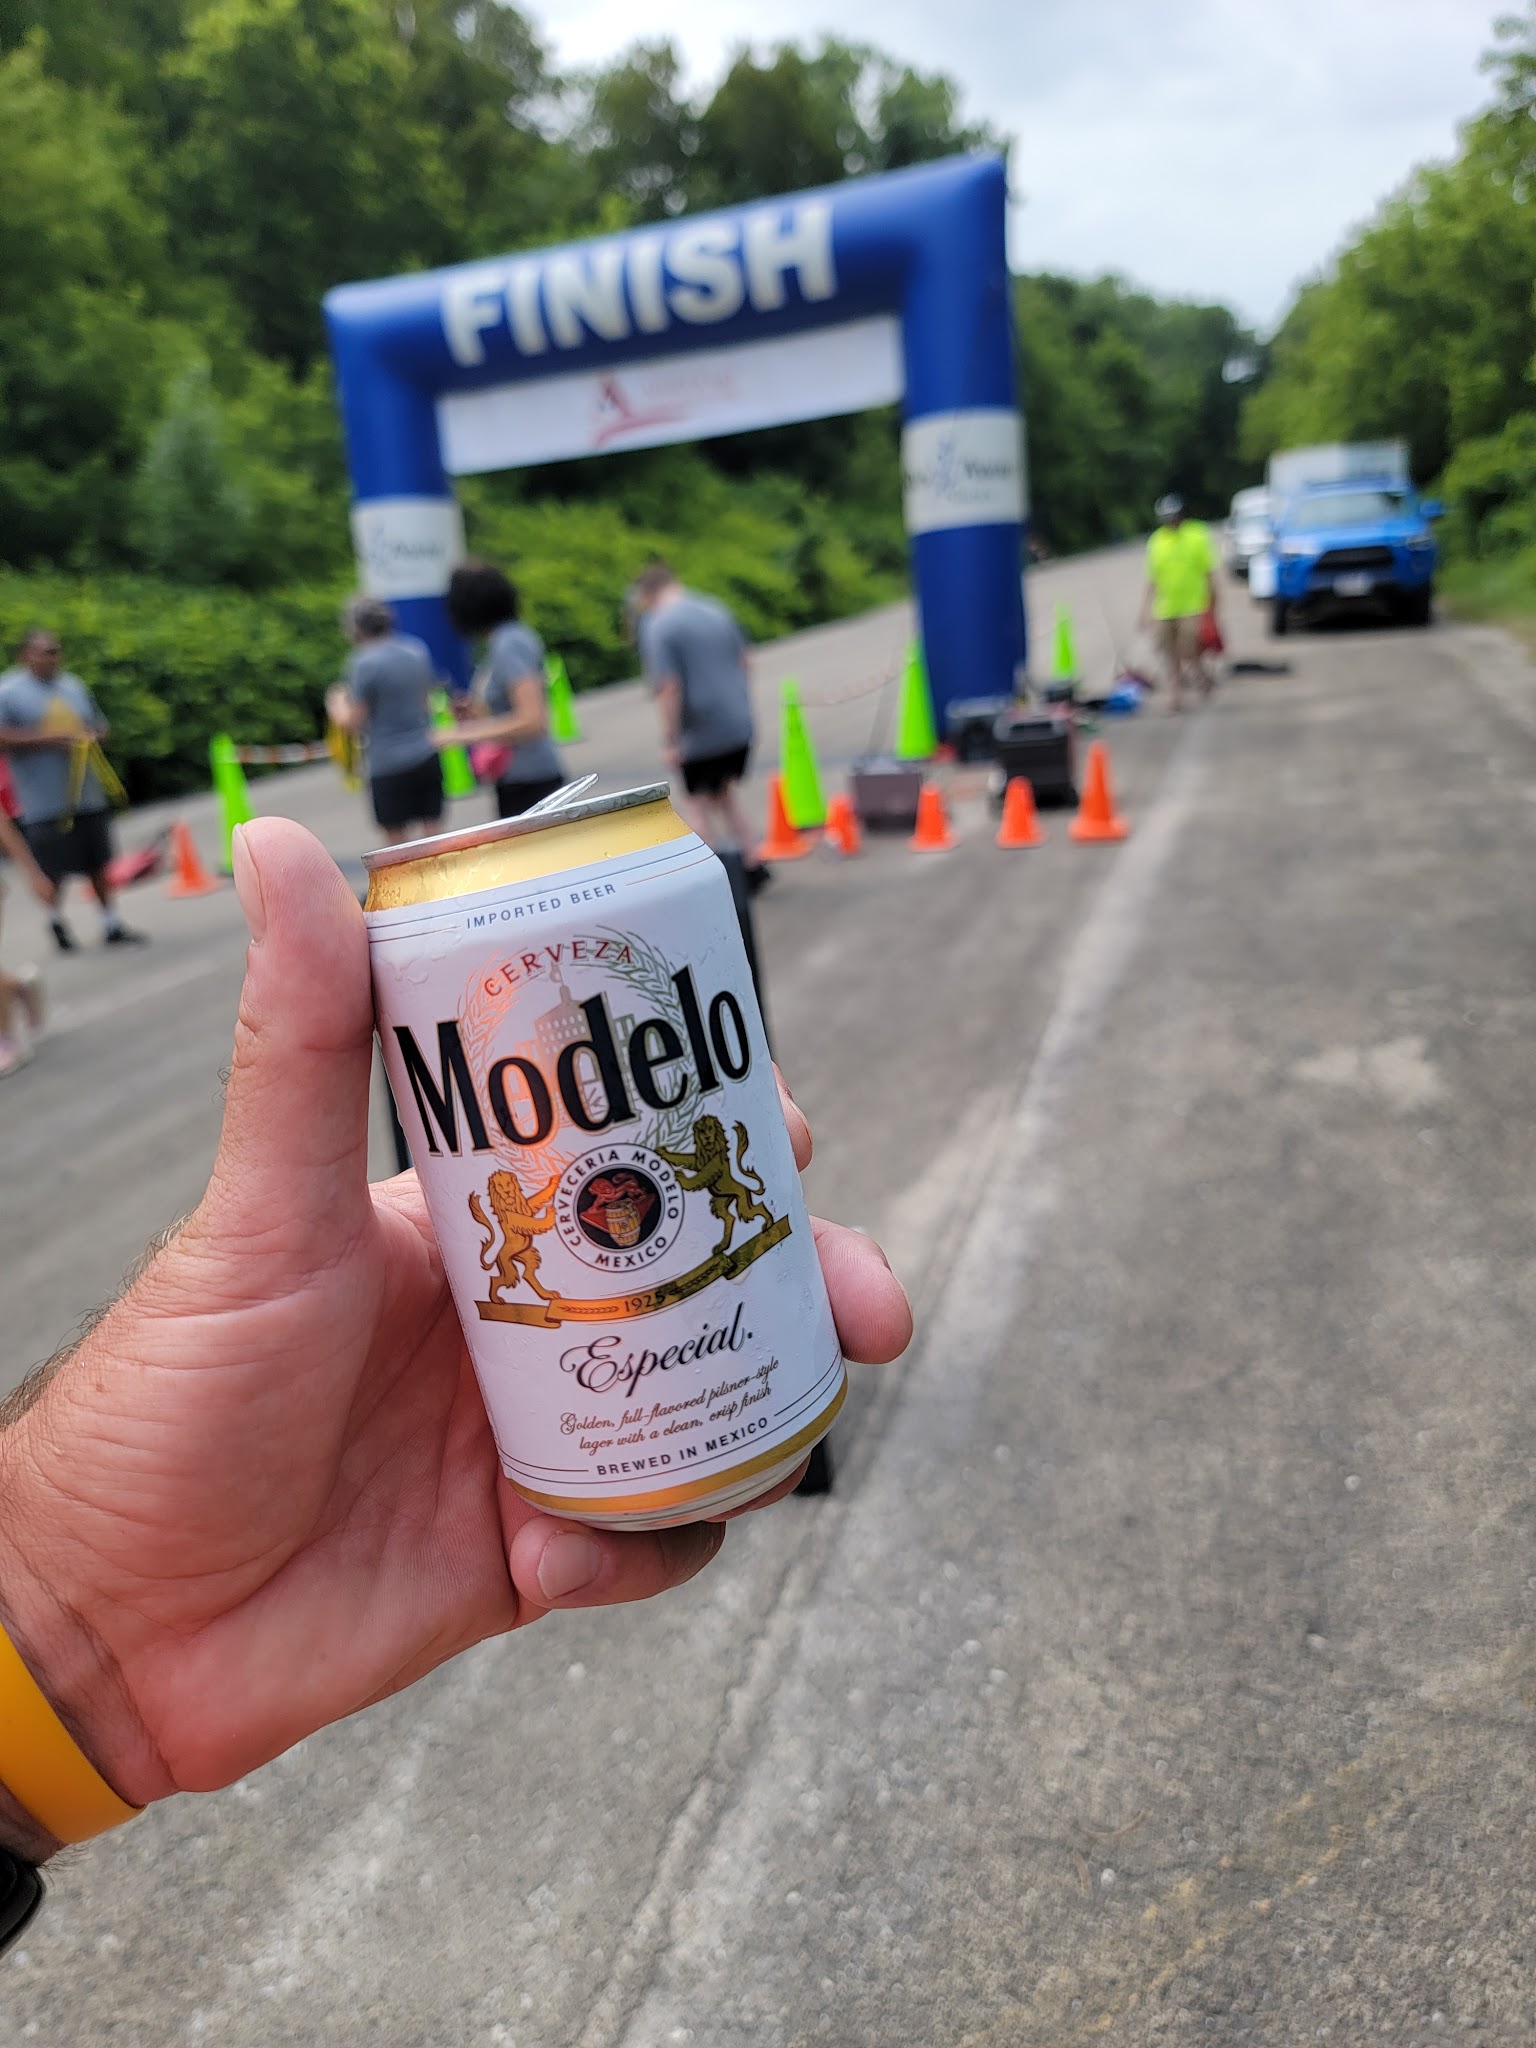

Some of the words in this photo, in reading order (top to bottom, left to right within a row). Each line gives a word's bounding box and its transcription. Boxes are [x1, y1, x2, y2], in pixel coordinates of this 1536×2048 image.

[440, 202, 838, 367] FINISH
[466, 898, 561, 929] IMPORTED
[570, 884, 616, 905] BEER
[484, 940, 633, 997] CERVEZA
[393, 964, 752, 1157] Modelo
[558, 1150, 619, 1246] CERVECERIA
[631, 1150, 679, 1219] MODELO
[595, 1236, 667, 1268] MEXICO
[624, 1292, 666, 1313] 1925
[560, 1412, 615, 1435] Golden,
[614, 1389, 706, 1431] full-flavored
[705, 1356, 779, 1408] pilsner-style
[579, 1437, 613, 1456] lager
[616, 1428, 646, 1446] with
[649, 1429, 659, 1440] a
[663, 1418, 704, 1436] clean,
[709, 1403, 738, 1421] crisp
[736, 1381, 772, 1416] finish
[597, 1453, 671, 1476] BREWED
[679, 1446, 698, 1460] IN
[706, 1417, 768, 1452] MEXICO
